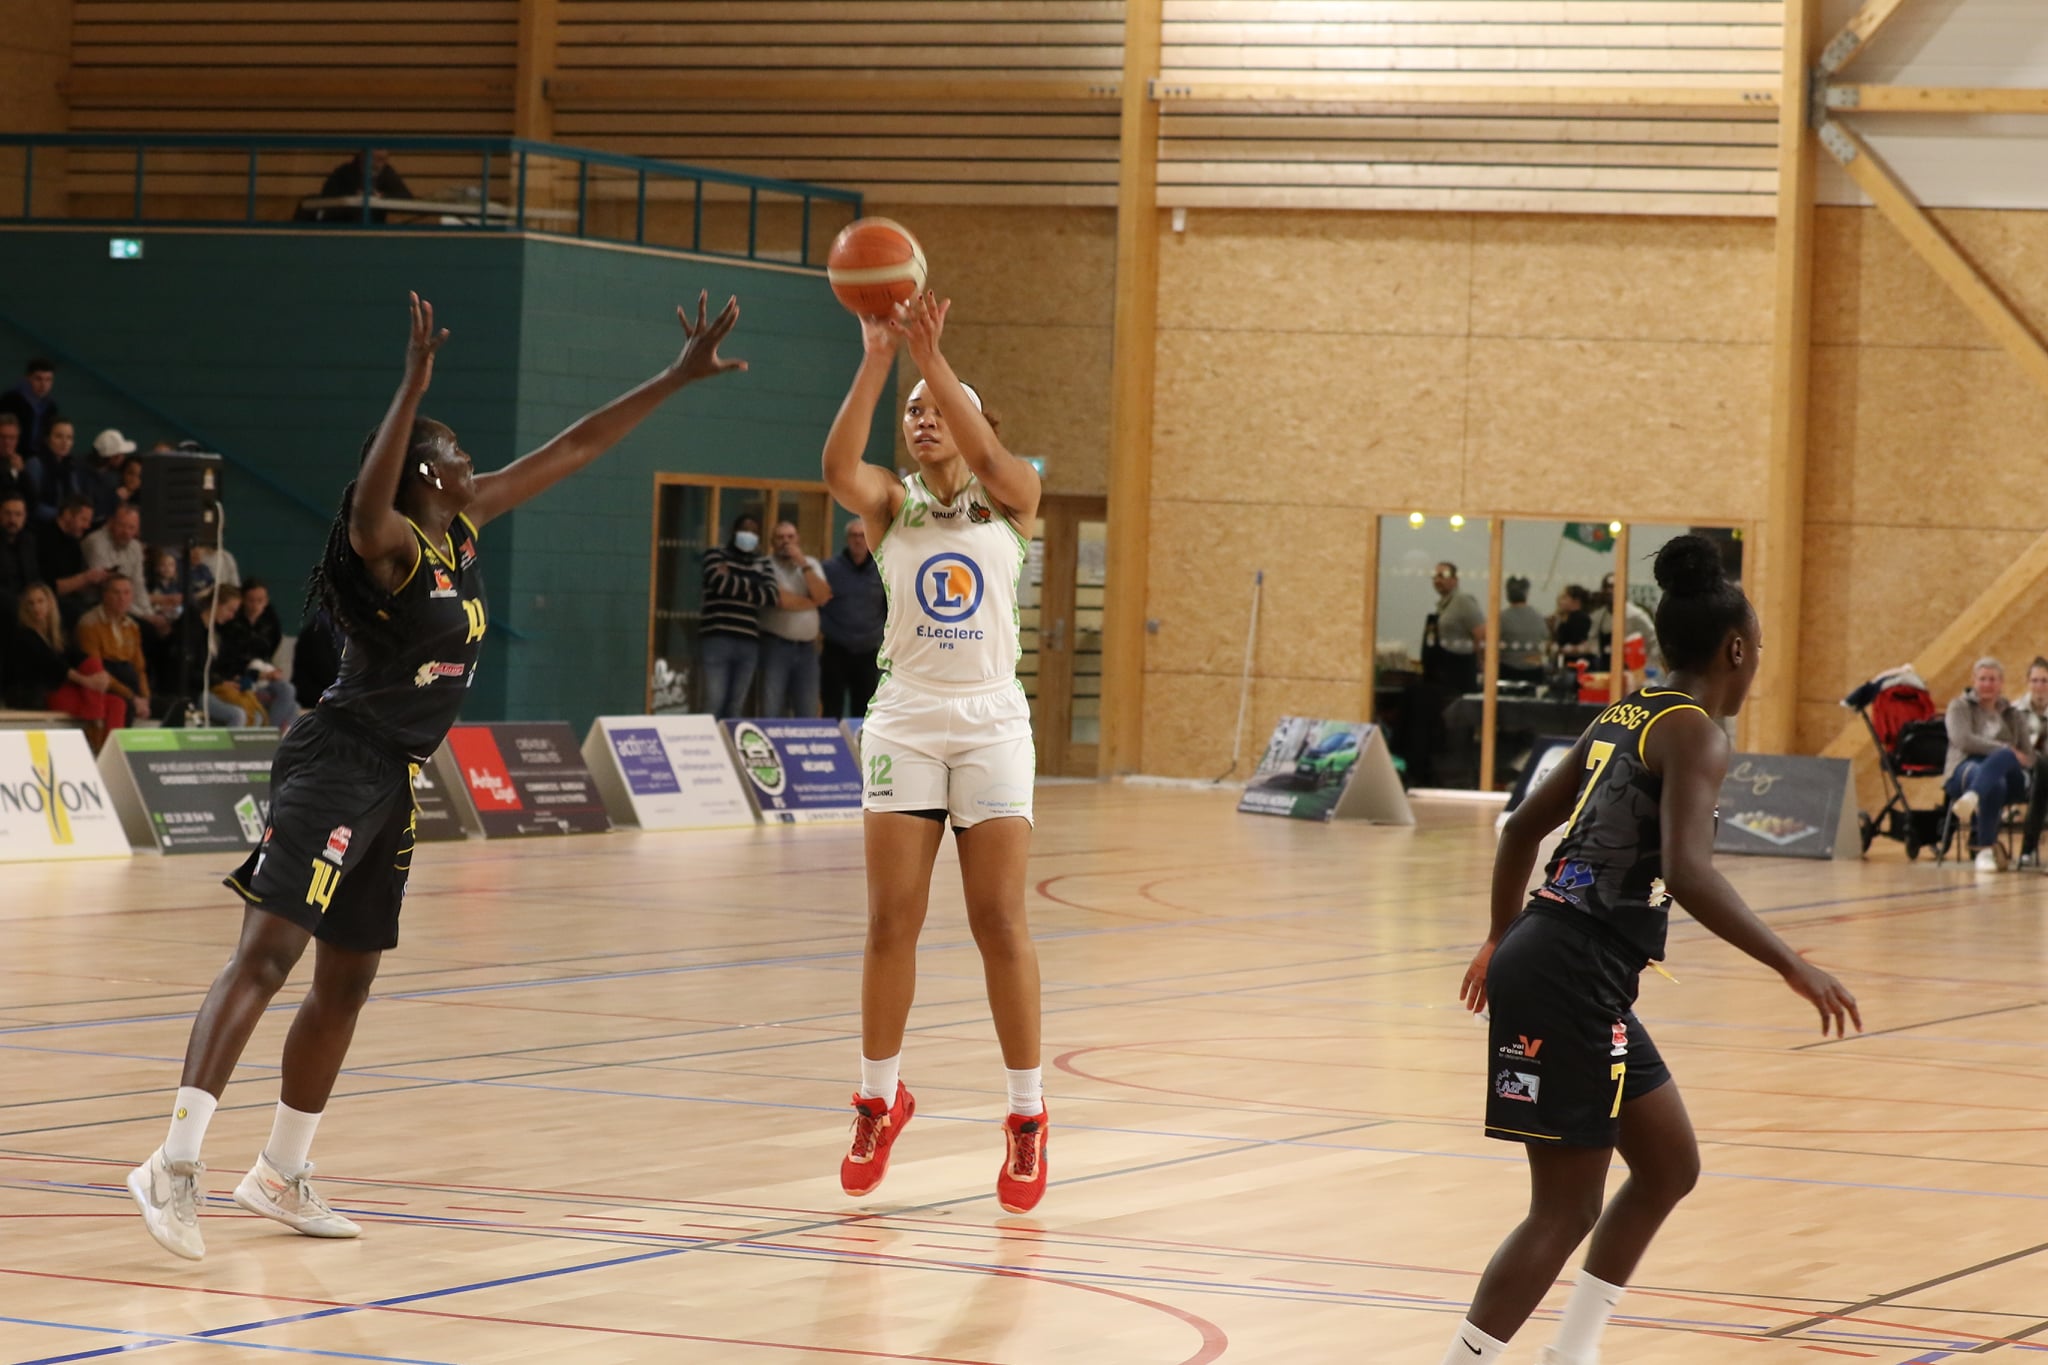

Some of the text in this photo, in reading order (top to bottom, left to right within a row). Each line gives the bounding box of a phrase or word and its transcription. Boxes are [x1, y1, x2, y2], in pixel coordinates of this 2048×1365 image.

[903, 498, 929, 528] 12
[462, 597, 487, 645] 14
[916, 625, 984, 640] E.Leclerc
[939, 642, 955, 650] IFS
[868, 753, 893, 786] 12
[1563, 739, 1617, 839] 7
[0, 750, 103, 839] NOYON
[306, 857, 341, 914] 14
[1609, 1061, 1627, 1118] 7
